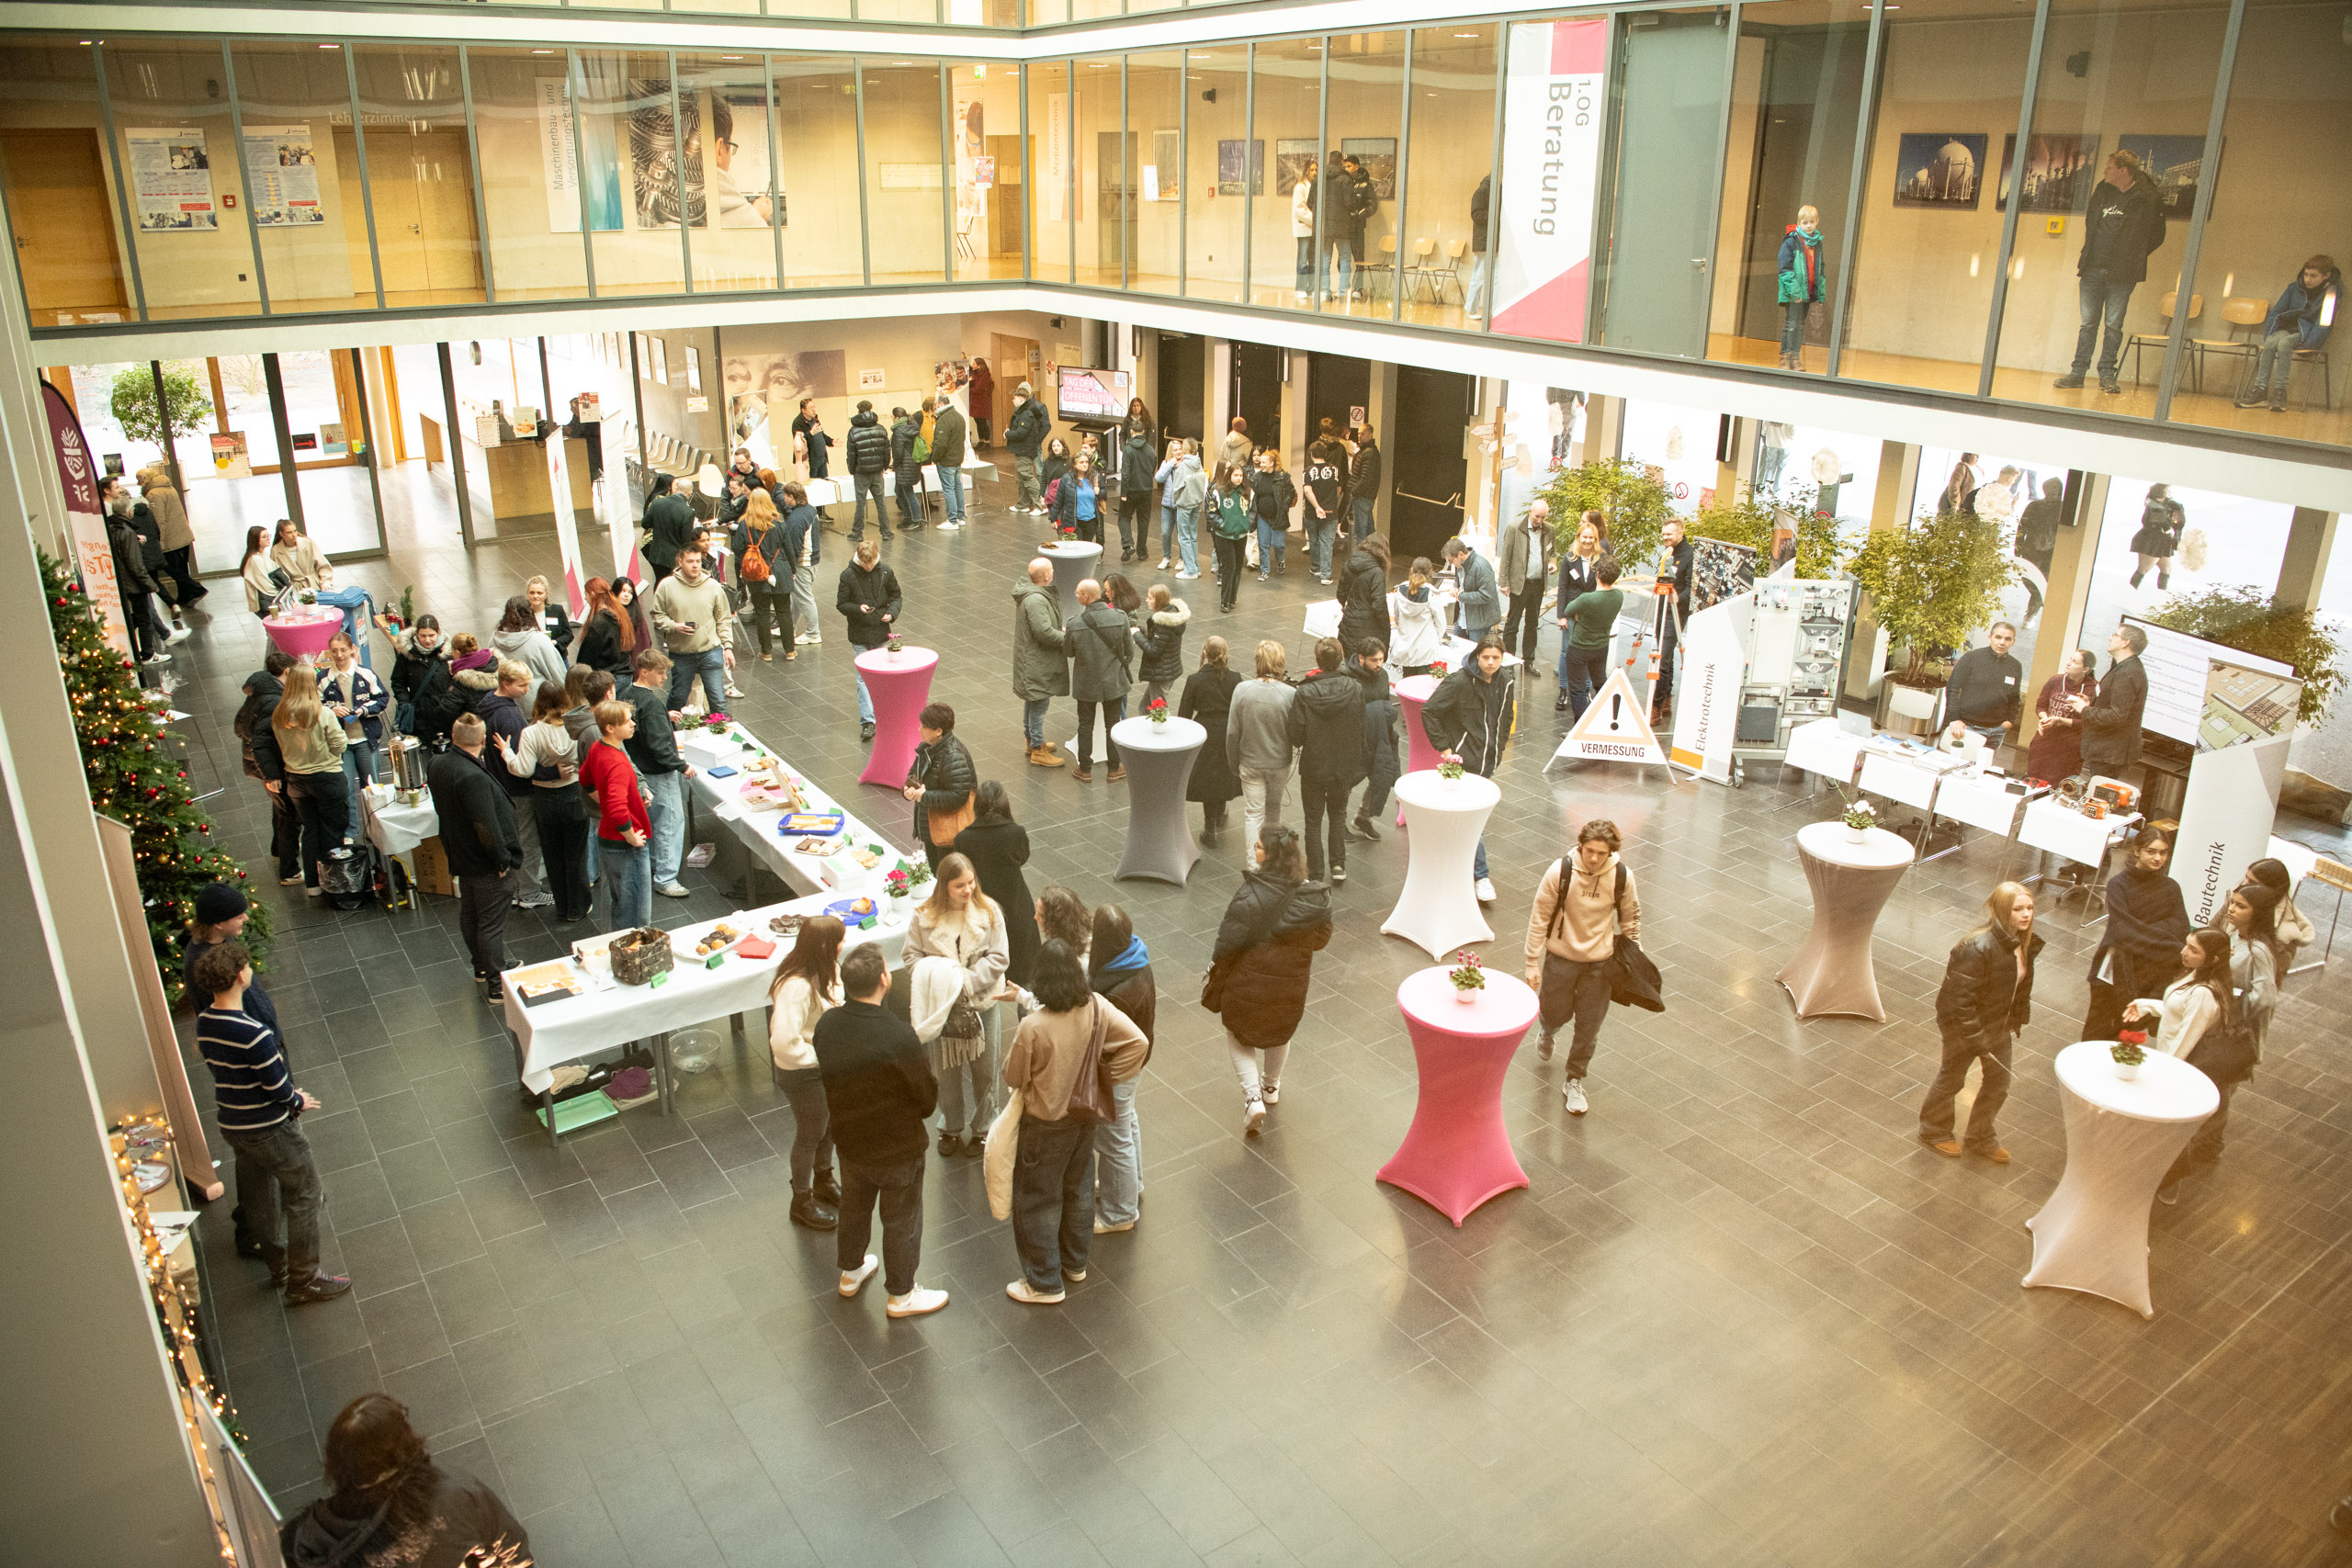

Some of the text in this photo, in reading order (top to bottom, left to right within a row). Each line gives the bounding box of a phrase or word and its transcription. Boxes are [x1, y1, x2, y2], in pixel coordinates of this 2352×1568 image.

[329, 111, 416, 125] Leherzimmer
[1575, 79, 1591, 126] 1.OG
[545, 85, 564, 190] Maschinenbau- und
[559, 85, 577, 187] Versorgungstechnik
[1532, 83, 1572, 236] Beratung
[1064, 377, 1095, 389] TAG DER
[1064, 391, 1098, 404] OFFENEN
[1695, 662, 1716, 751] Elektrotechnik
[1581, 743, 1645, 758] VERMESSUNG
[2194, 841, 2225, 926] Bautechnik
